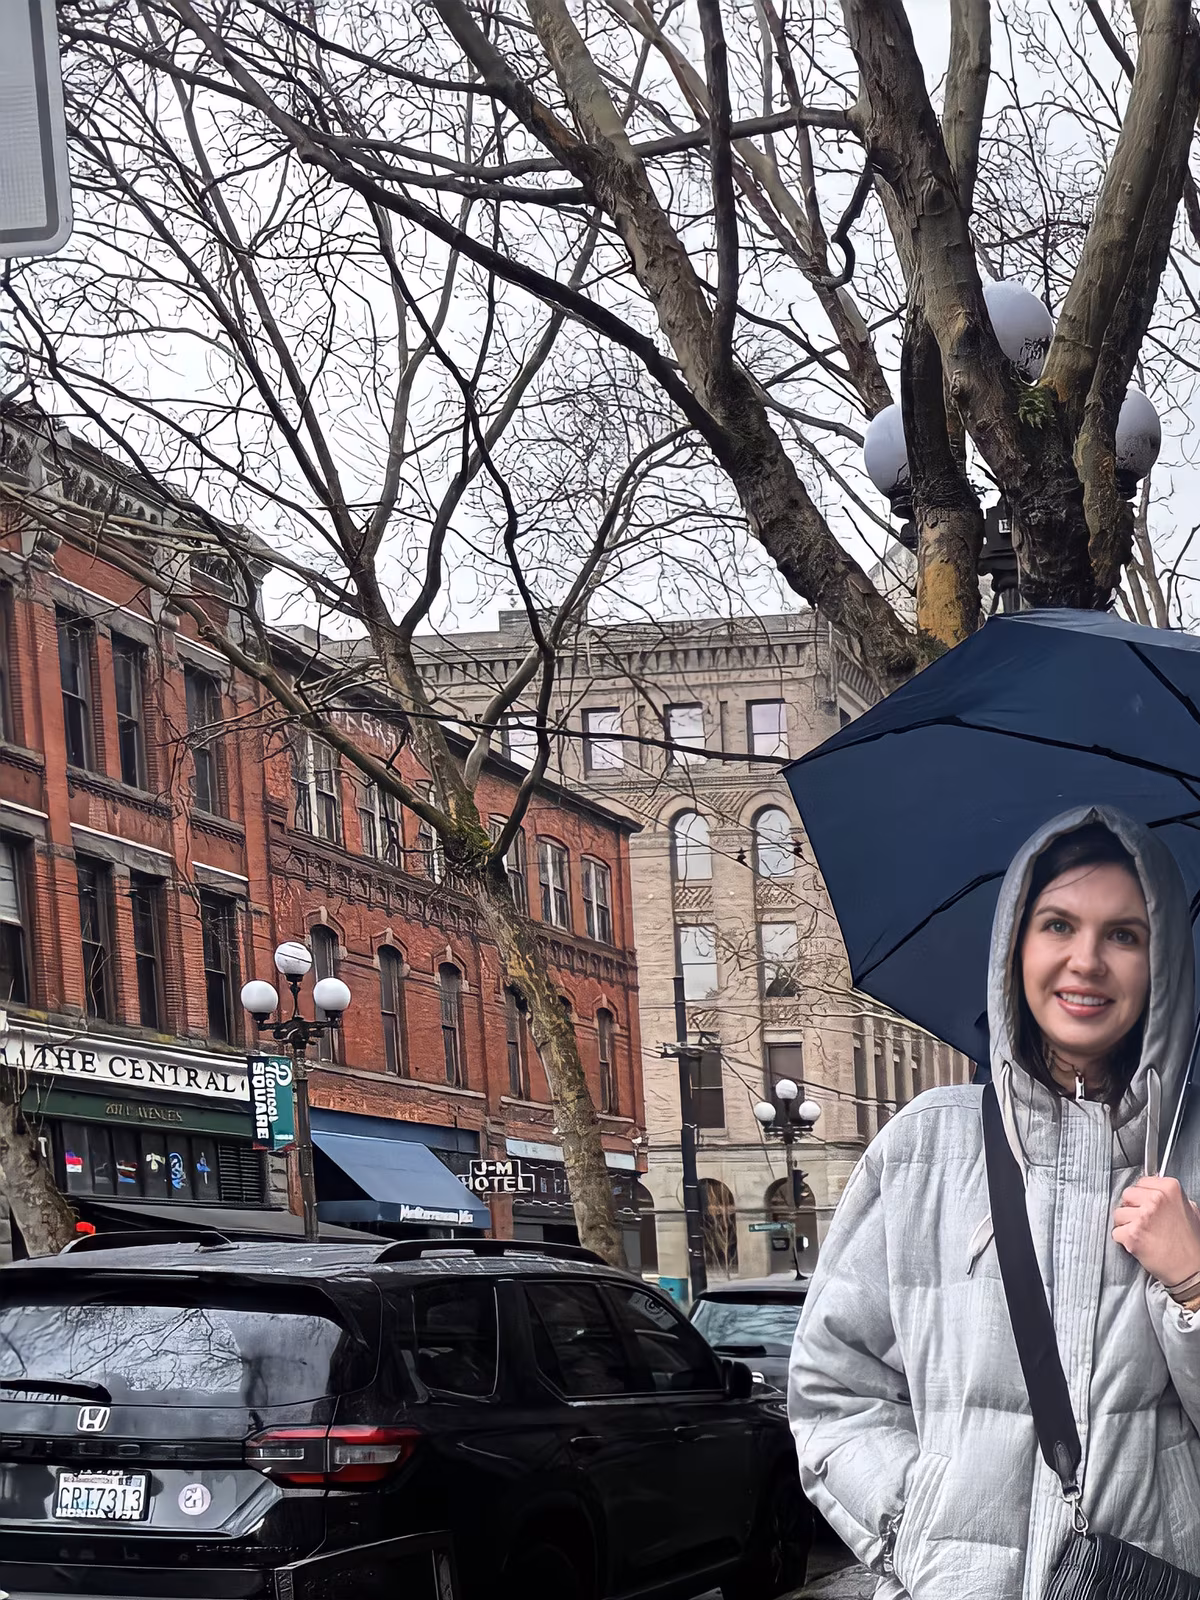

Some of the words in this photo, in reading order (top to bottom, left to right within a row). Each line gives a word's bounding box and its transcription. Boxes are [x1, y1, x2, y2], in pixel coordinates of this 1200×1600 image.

[33, 1043, 97, 1074] THE
[108, 1056, 236, 1093] CENTRAL
[252, 1062, 270, 1139] SQUARE
[474, 1161, 513, 1175] J-M
[461, 1176, 531, 1192] HOTEL
[60, 1487, 142, 1513] CRT7313
